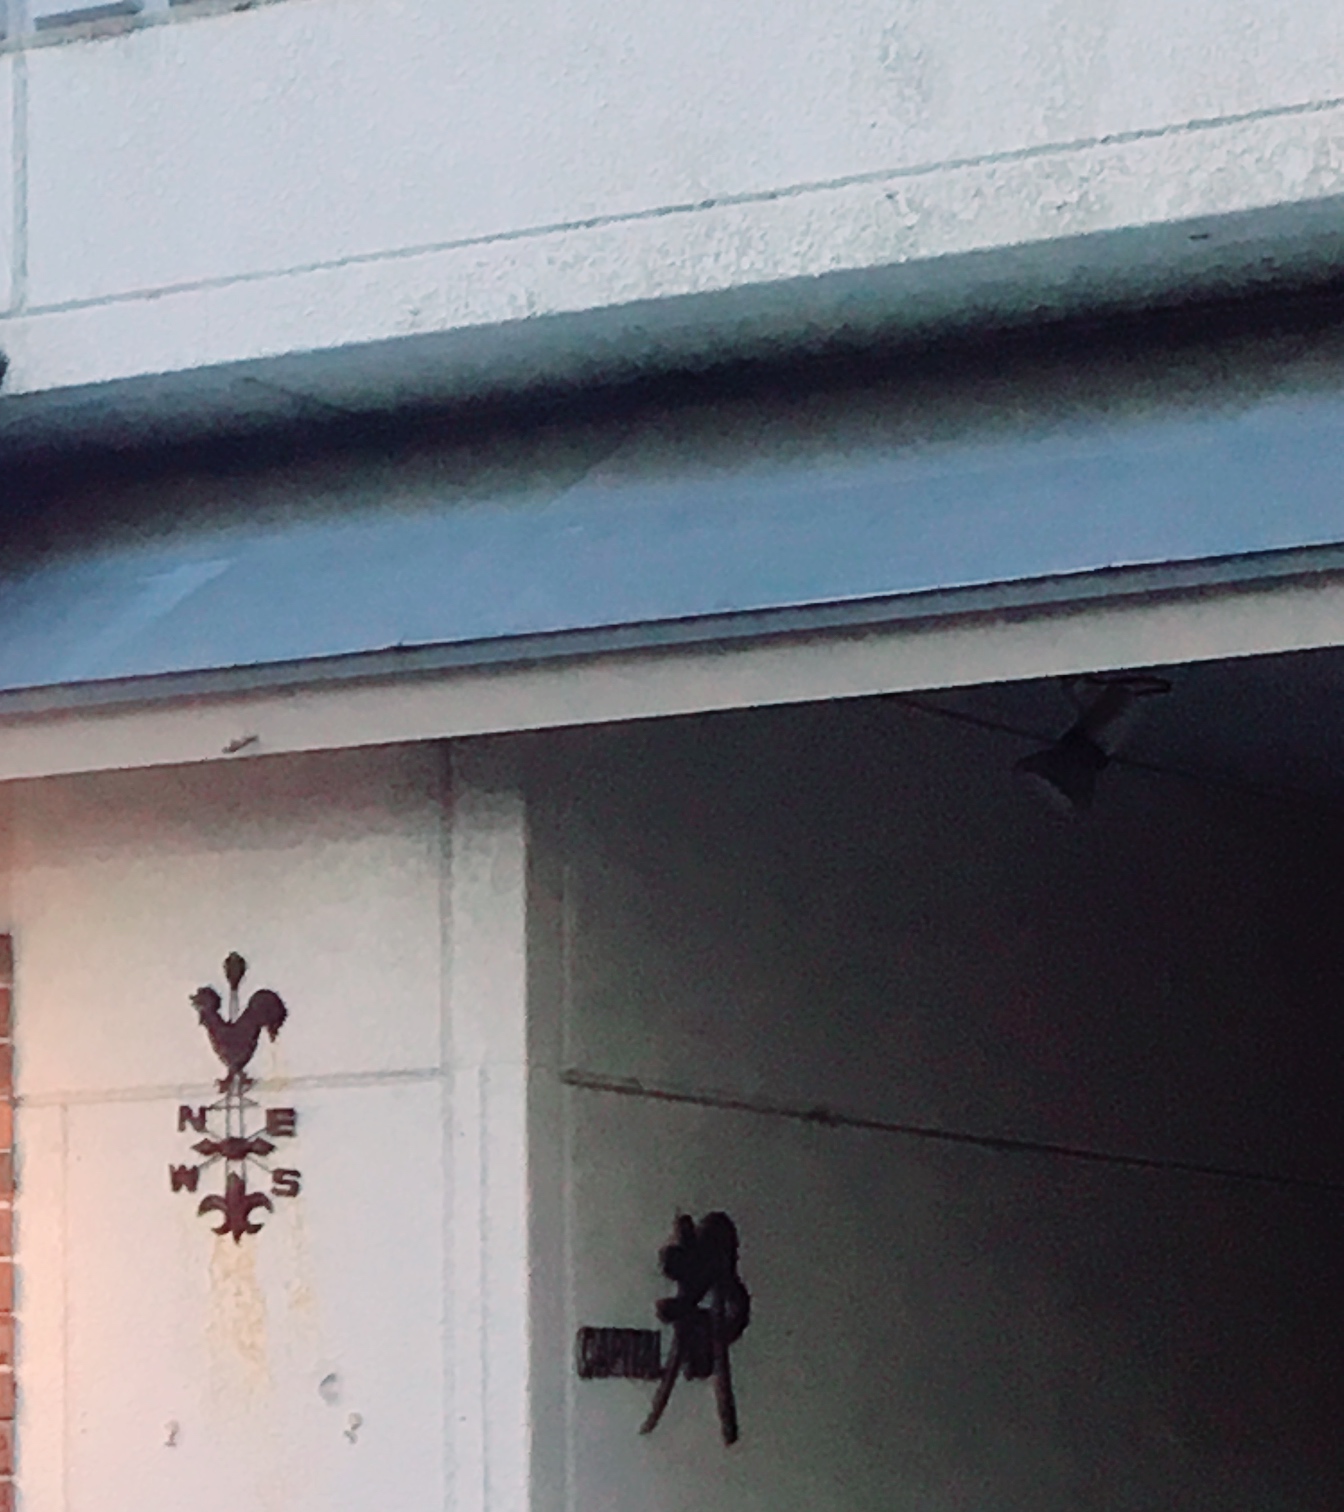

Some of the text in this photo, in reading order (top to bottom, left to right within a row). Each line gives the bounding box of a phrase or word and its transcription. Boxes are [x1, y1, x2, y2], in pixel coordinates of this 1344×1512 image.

[178, 1106, 297, 1137] N E
[169, 1164, 301, 1198] W S
